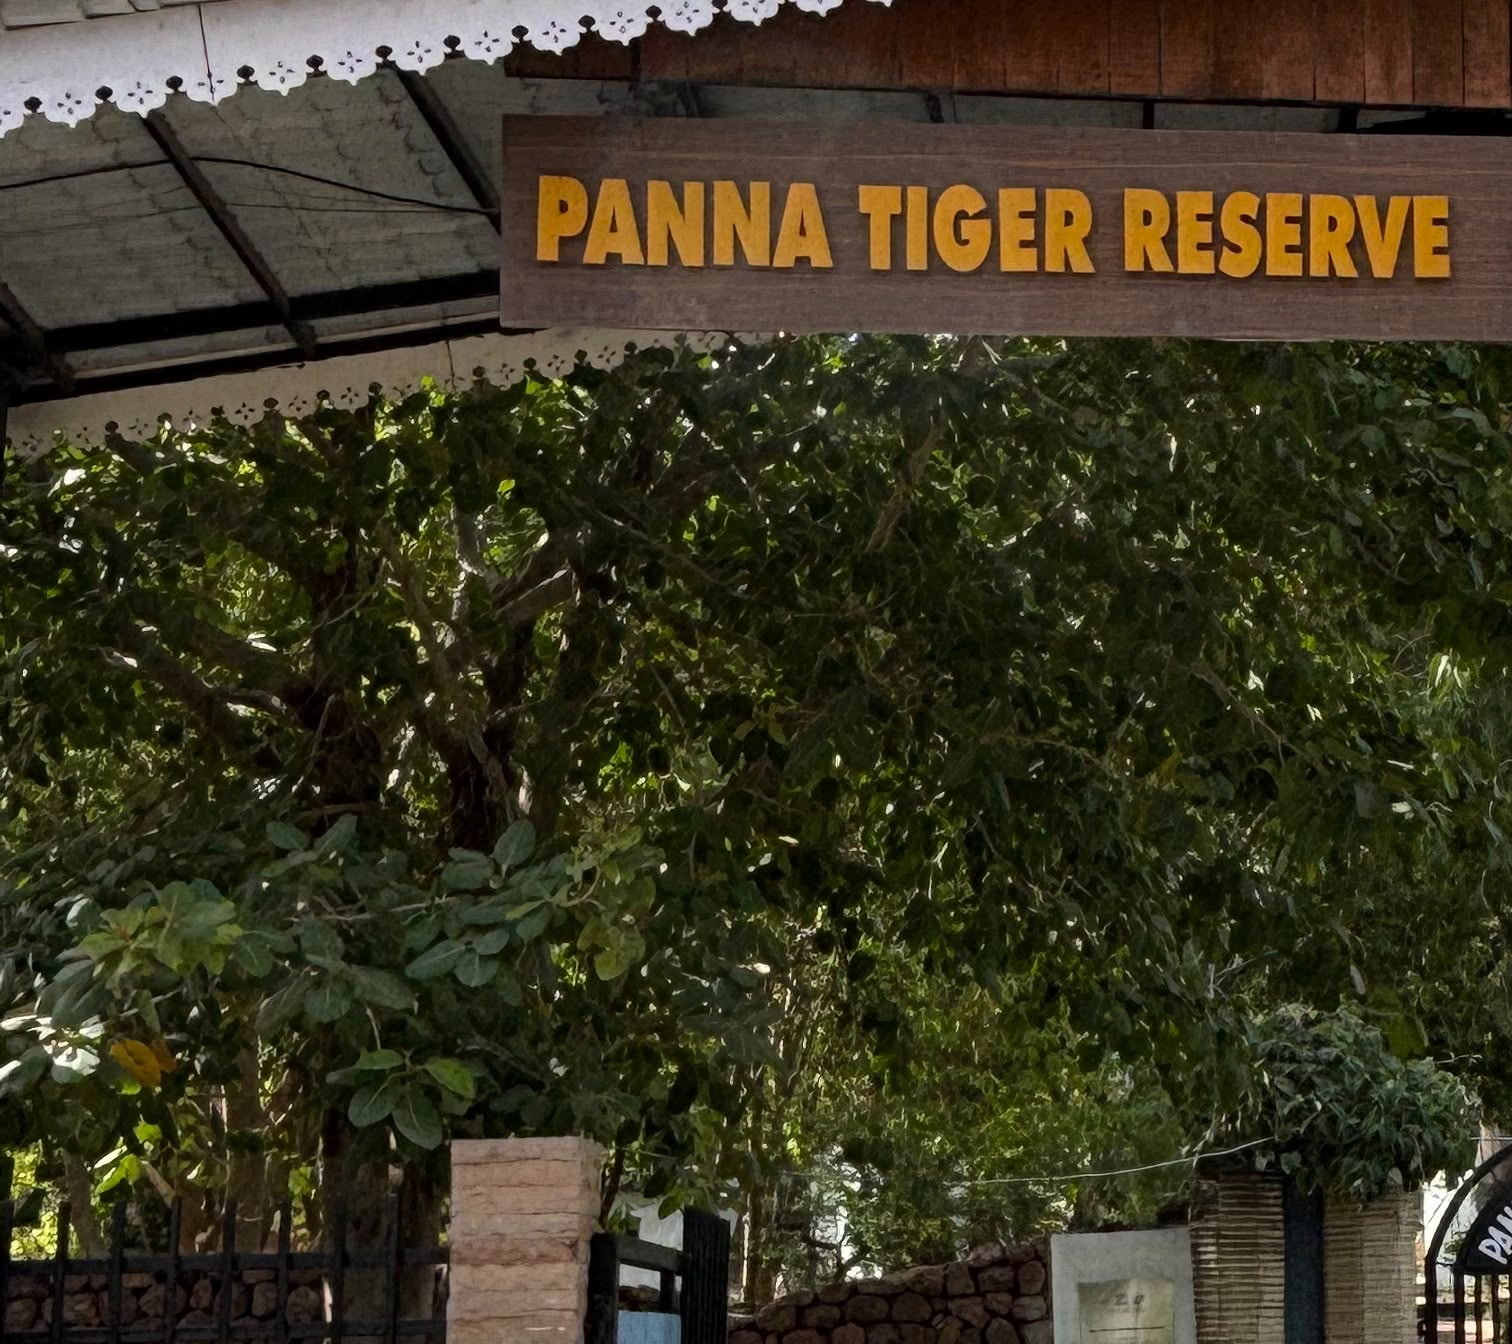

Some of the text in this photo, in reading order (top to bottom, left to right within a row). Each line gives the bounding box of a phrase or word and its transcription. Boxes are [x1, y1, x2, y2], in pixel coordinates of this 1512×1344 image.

[536, 175, 1452, 278] PANNA TIGER RESERVE
